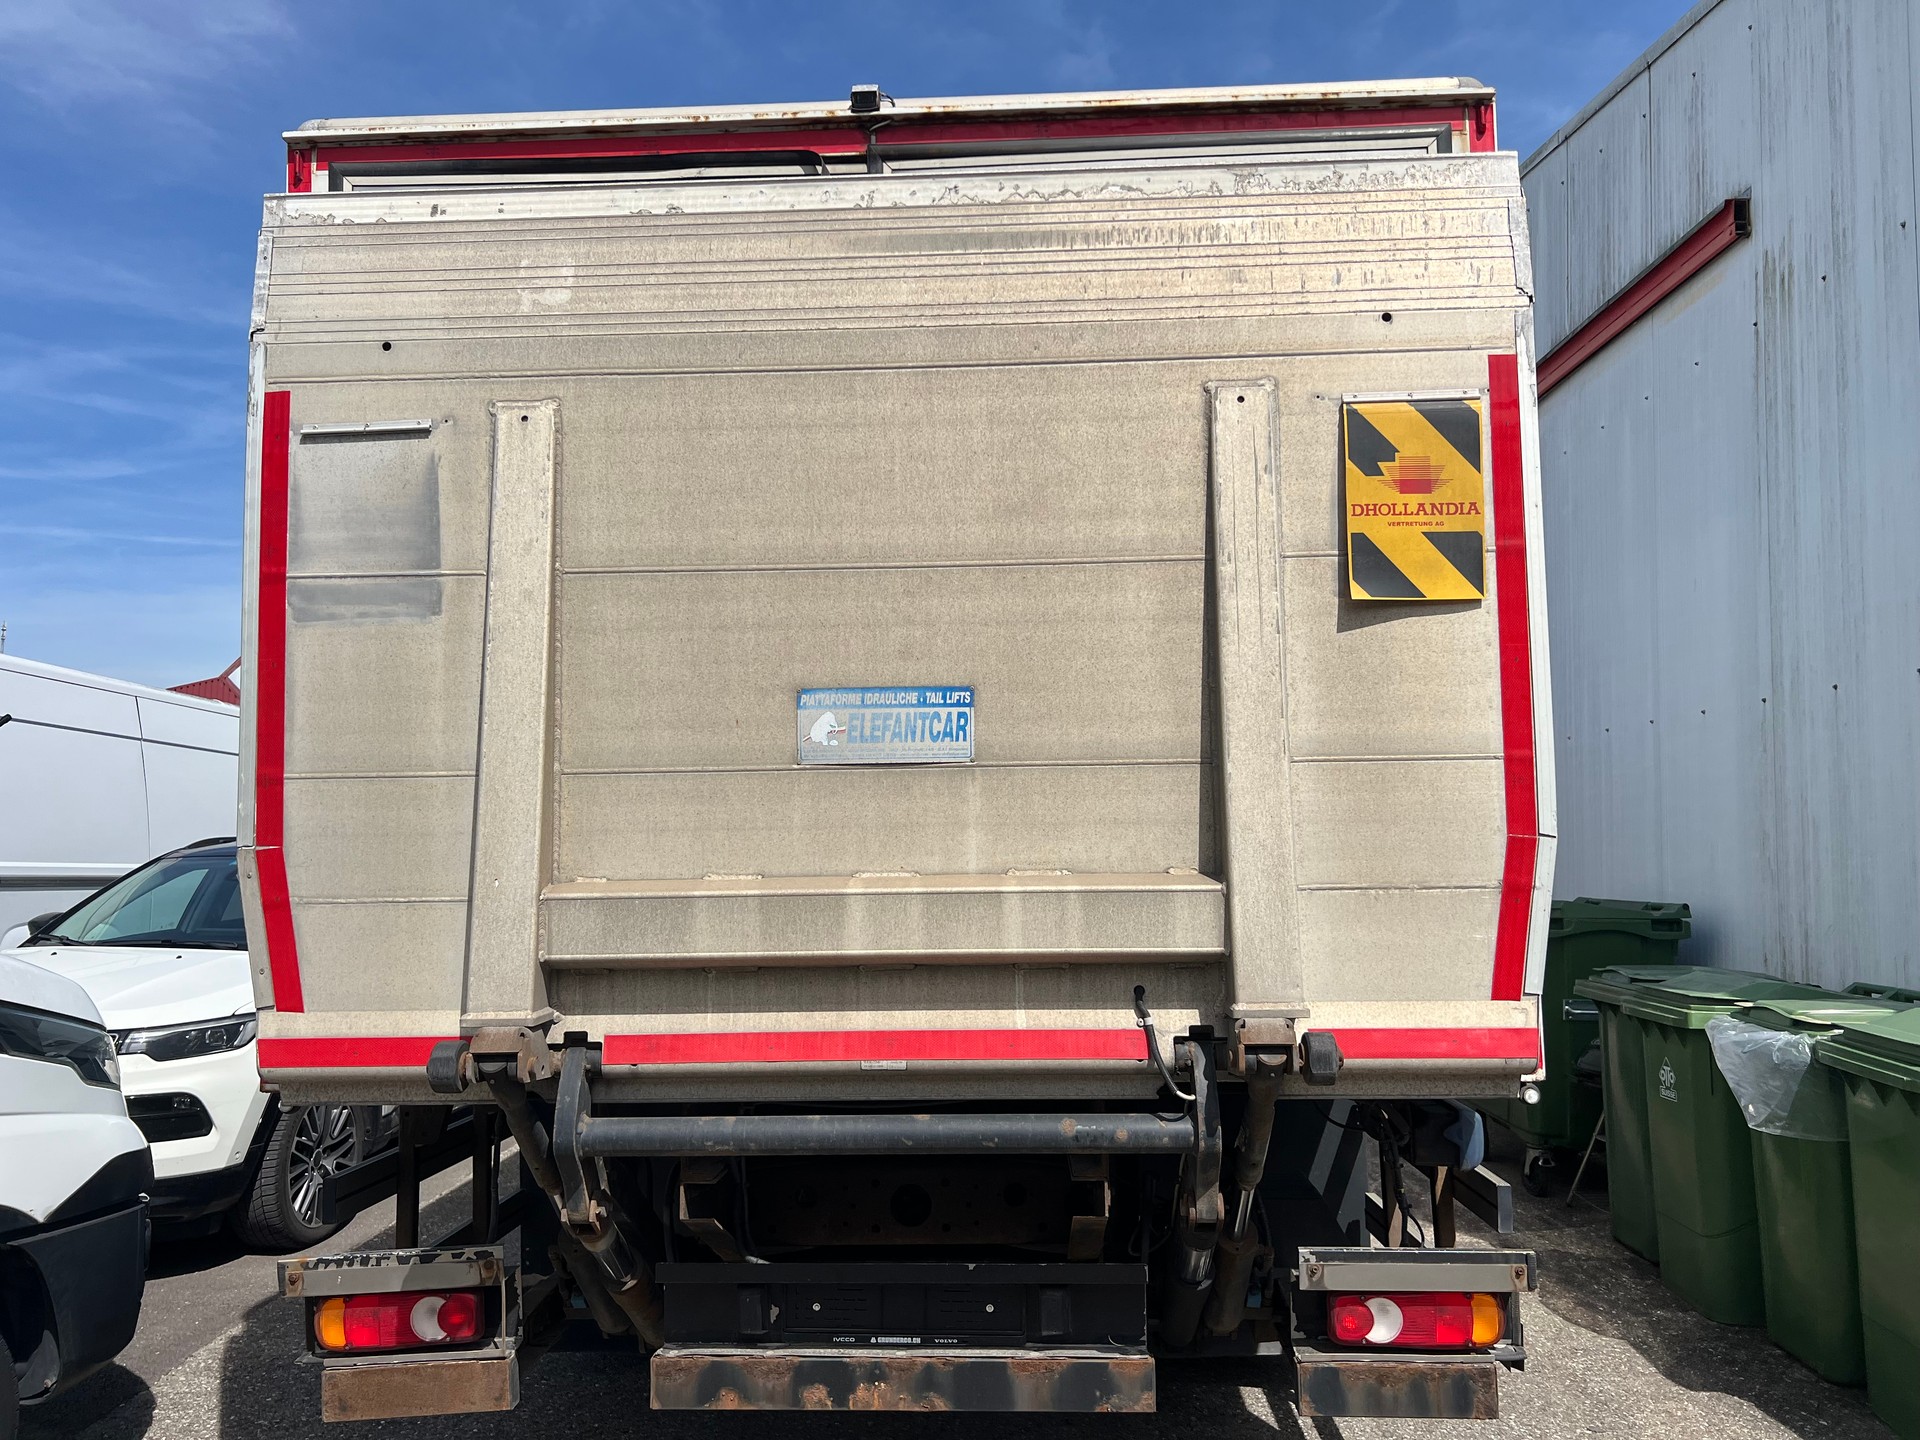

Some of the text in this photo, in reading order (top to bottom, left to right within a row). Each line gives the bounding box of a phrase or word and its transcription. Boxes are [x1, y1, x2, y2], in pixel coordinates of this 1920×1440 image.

[1351, 502, 1481, 517] DHOLLANDIA
[800, 692, 971, 706] PIATTAFORME IDRAULICHE TAIL LIFTS
[847, 711, 969, 744] ELEFANTCAR
